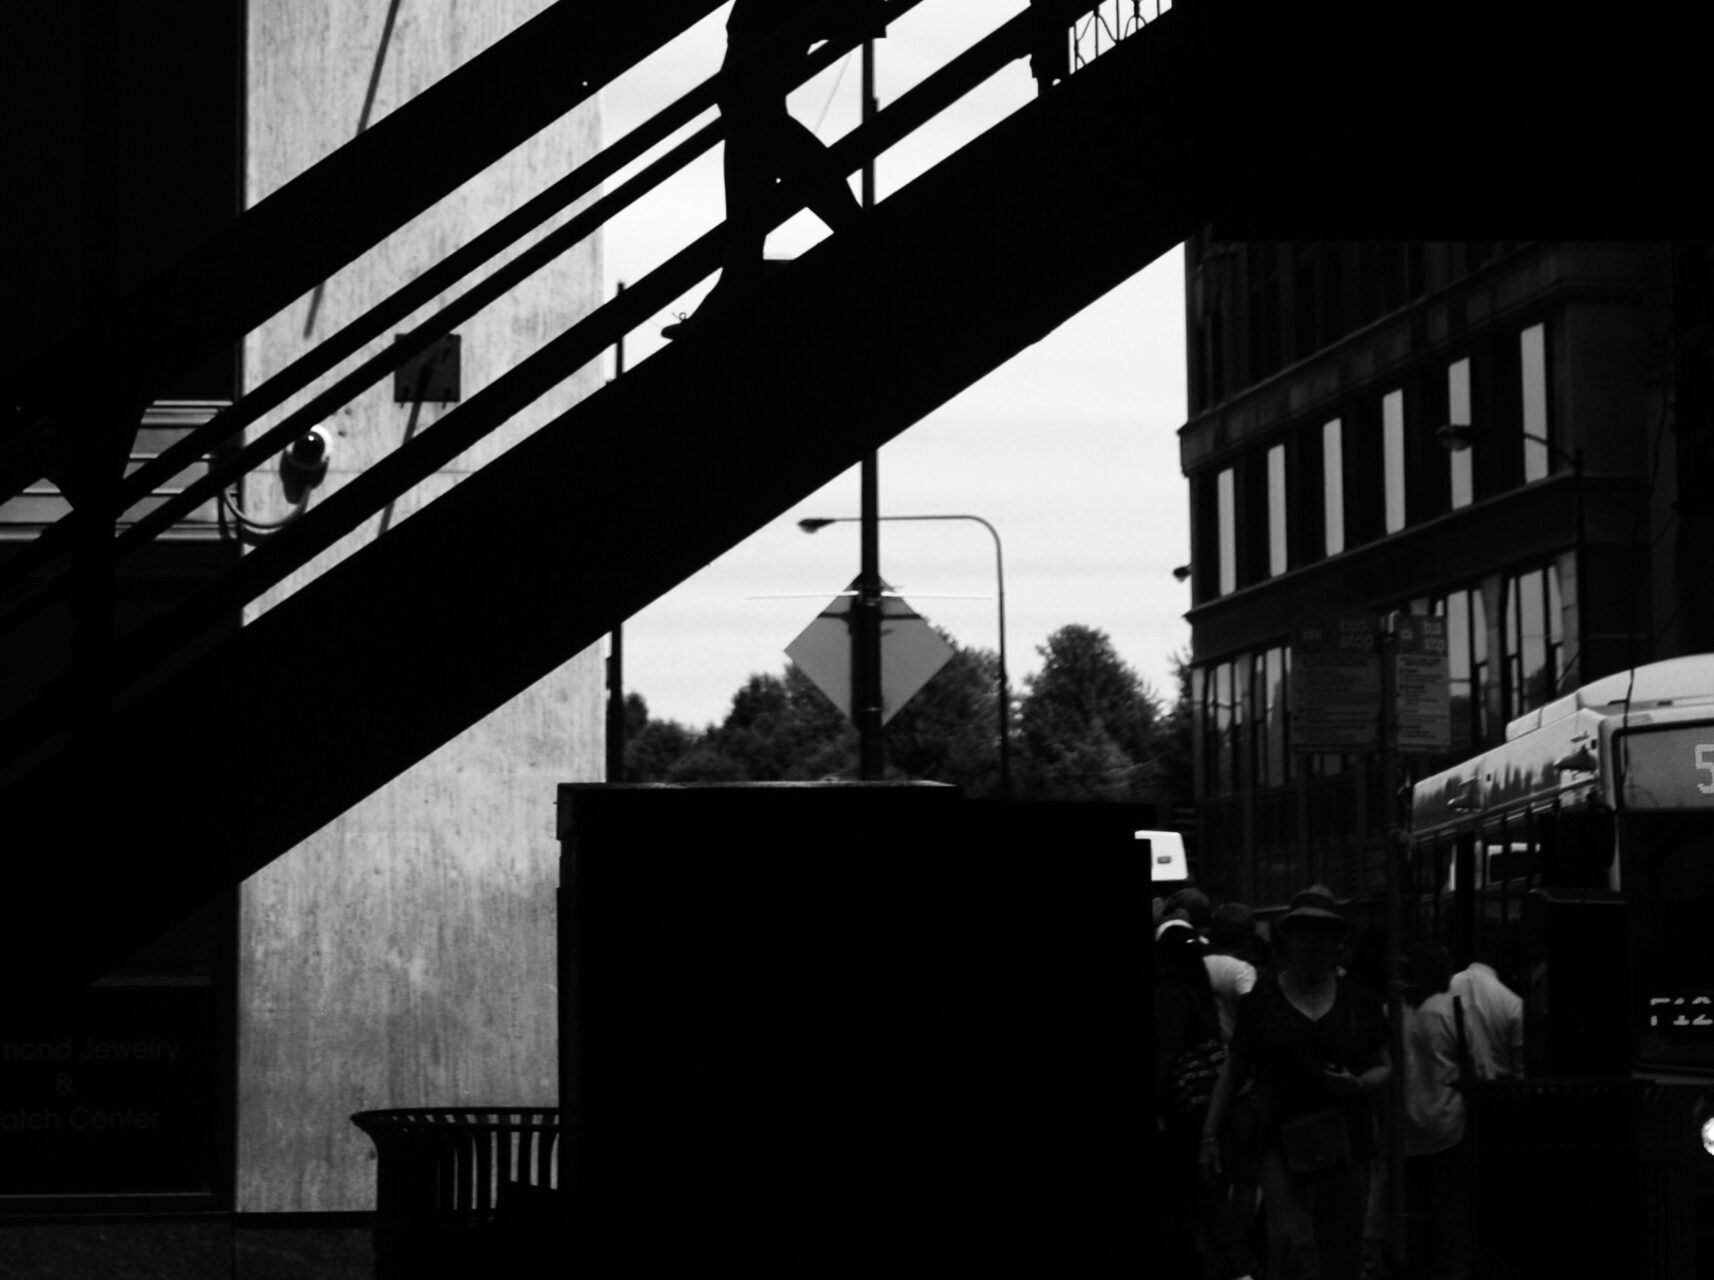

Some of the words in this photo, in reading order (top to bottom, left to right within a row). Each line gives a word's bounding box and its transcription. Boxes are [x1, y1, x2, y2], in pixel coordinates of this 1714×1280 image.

[1339, 616, 1369, 632] bus
[1339, 634, 1374, 652] stop
[80, 1036, 182, 1063] Jewelry
[54, 1072, 77, 1096] &
[0, 1106, 63, 1131] atch
[69, 1106, 161, 1131] Center
